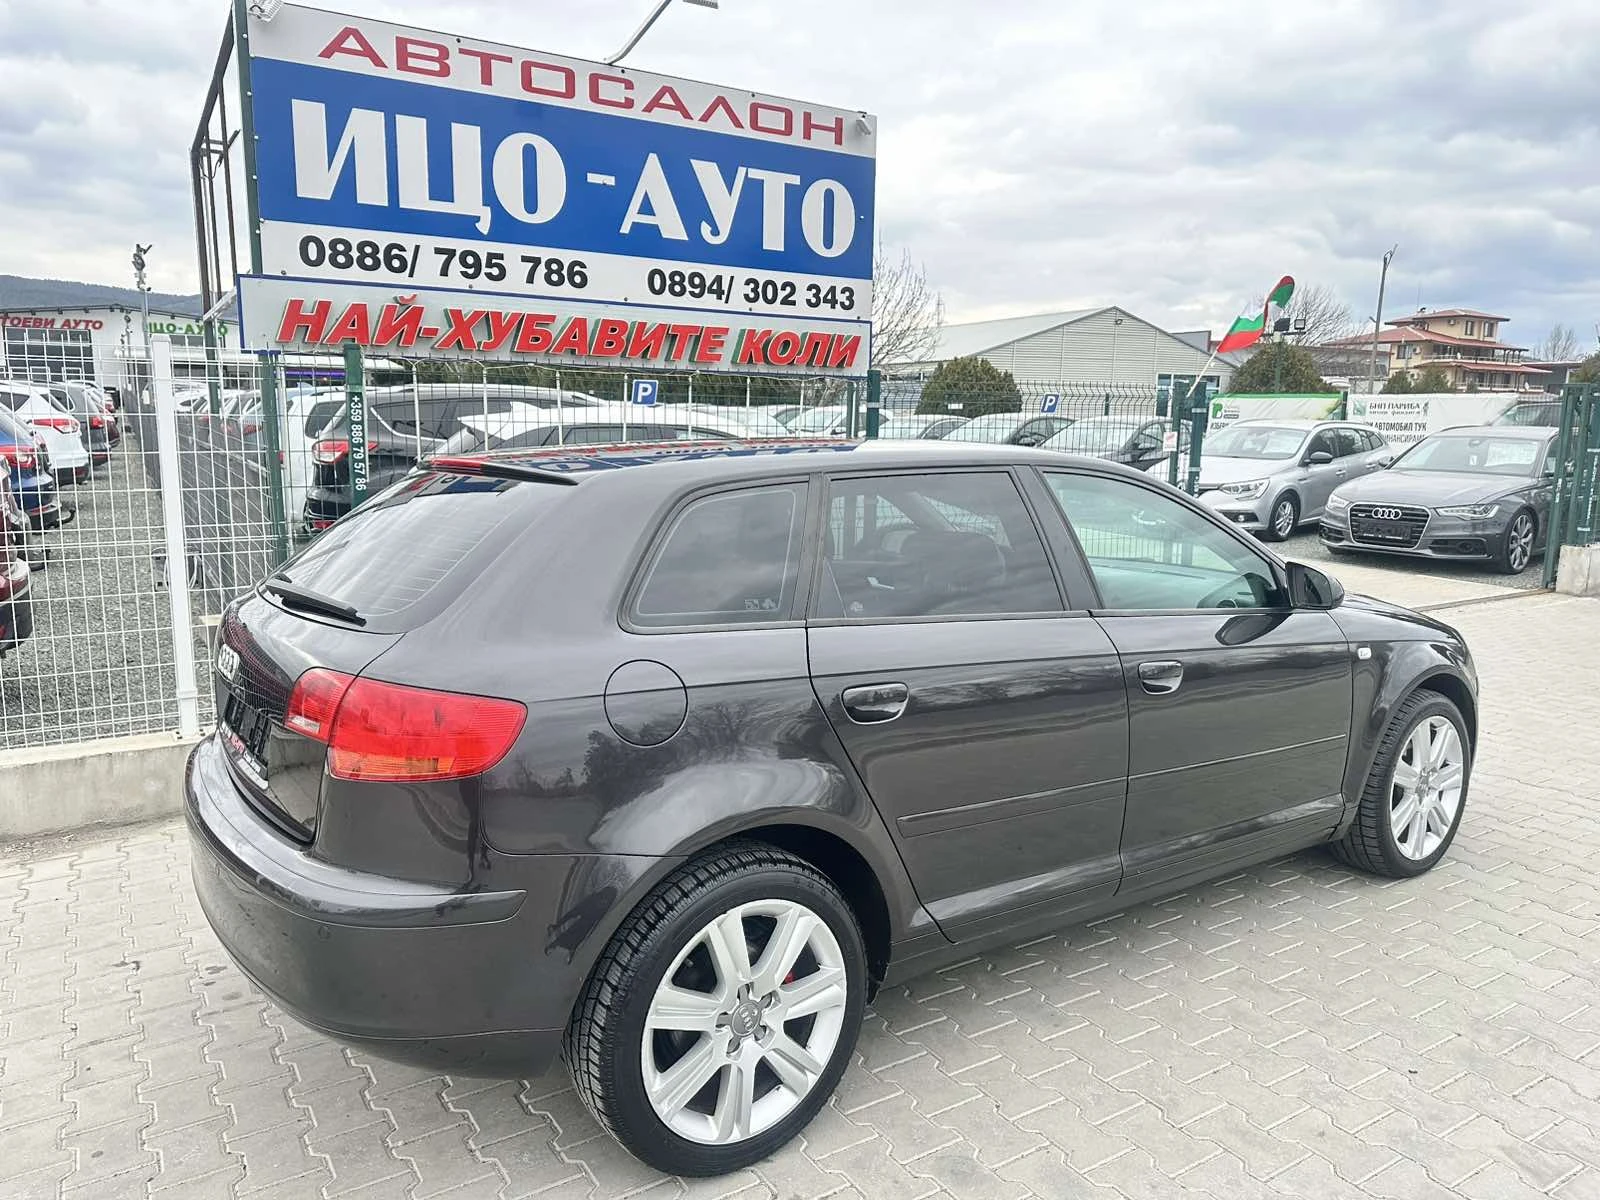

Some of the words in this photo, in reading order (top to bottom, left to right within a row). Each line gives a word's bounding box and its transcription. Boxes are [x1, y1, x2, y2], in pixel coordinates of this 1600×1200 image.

[319, 26, 843, 146] АВТОСАЛОН
[298, 235, 420, 278] 0886/
[433, 246, 508, 282] 795
[520, 255, 588, 289] 786
[647, 268, 735, 304] 0894/
[743, 277, 797, 307] 302
[805, 283, 856, 311] 343
[61, 318, 104, 331] АУТО
[276, 293, 730, 364] НАЙ-ХУБАВИТЕ
[734, 328, 862, 369] КОЛИ
[638, 384, 653, 402] P
[350, 395, 362, 421] +359
[1043, 395, 1057, 411] P
[351, 424, 363, 444] 886
[353, 446, 364, 459] 79
[354, 462, 366, 475] 57
[355, 477, 367, 491] 86
